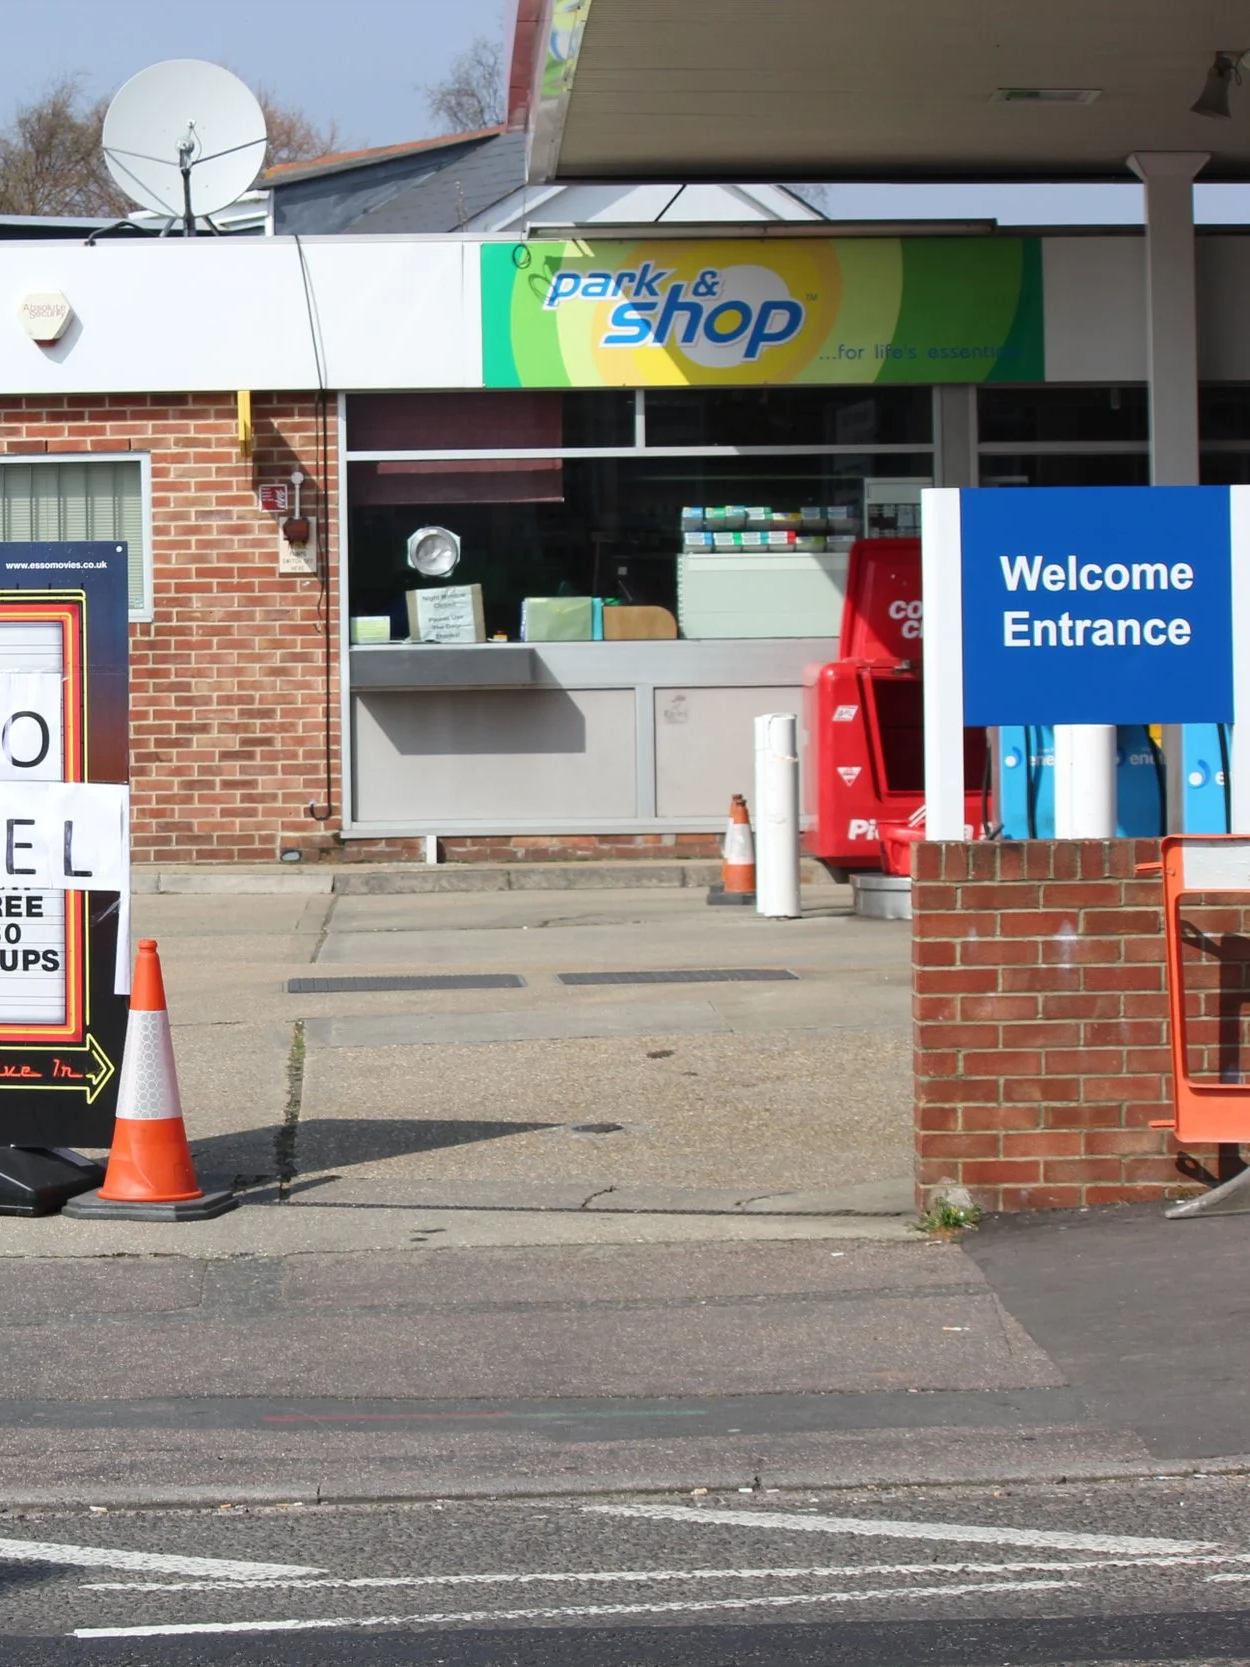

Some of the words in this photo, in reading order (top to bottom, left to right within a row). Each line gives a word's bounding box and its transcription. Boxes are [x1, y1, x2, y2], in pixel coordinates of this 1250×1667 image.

[547, 263, 669, 306] park
[692, 270, 720, 298] &
[603, 284, 803, 359] shop
[875, 344, 917, 359] life's
[927, 344, 1021, 359] essenti
[5, 561, 108, 570] www.essomovies.co.uk
[1000, 555, 1194, 591] Welcome
[1003, 611, 1191, 647] Entrance
[0, 949, 60, 972] UPS
[52, 1058, 84, 1079] In
